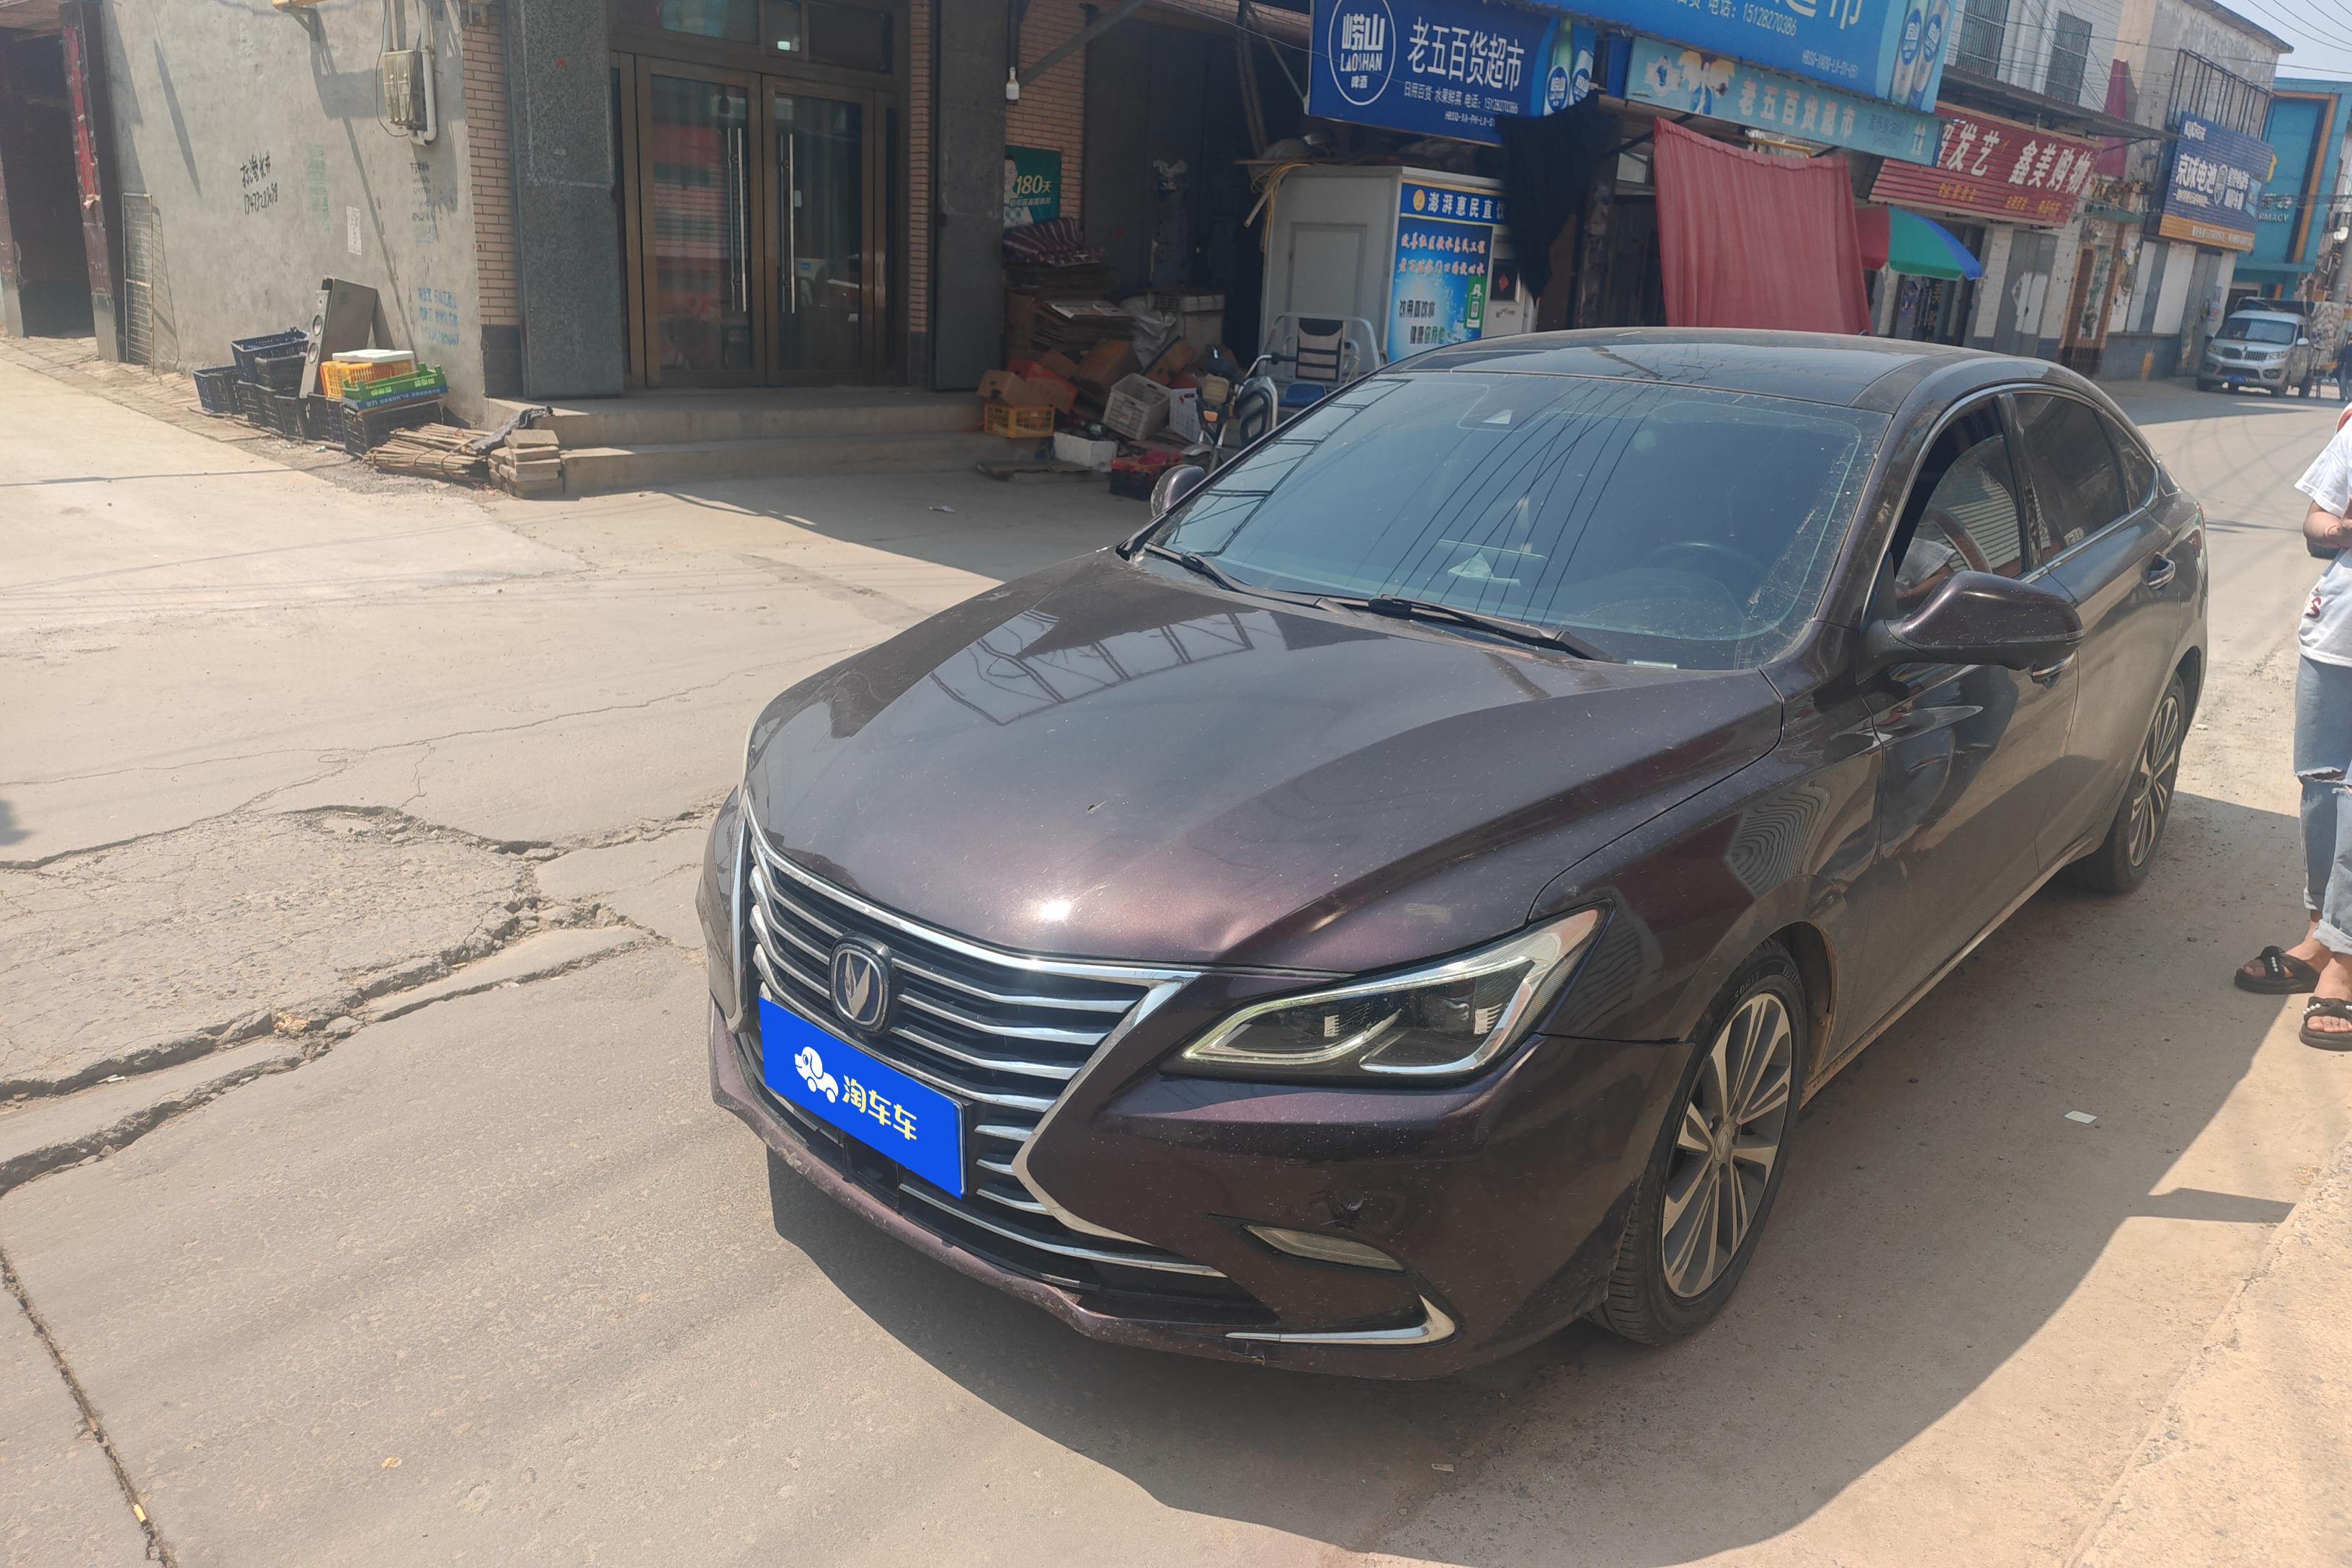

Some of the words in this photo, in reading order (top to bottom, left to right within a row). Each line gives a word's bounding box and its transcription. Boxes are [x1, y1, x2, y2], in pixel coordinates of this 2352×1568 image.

[1342, 13, 1386, 50] 崂山
[1340, 53, 1383, 72] LAOSHAN
[1407, 16, 1525, 92] 老五百货超市
[1350, 75, 1368, 89] 啤酒
[2008, 140, 2091, 195] 鑫美购物
[1016, 174, 1052, 195] 180天
